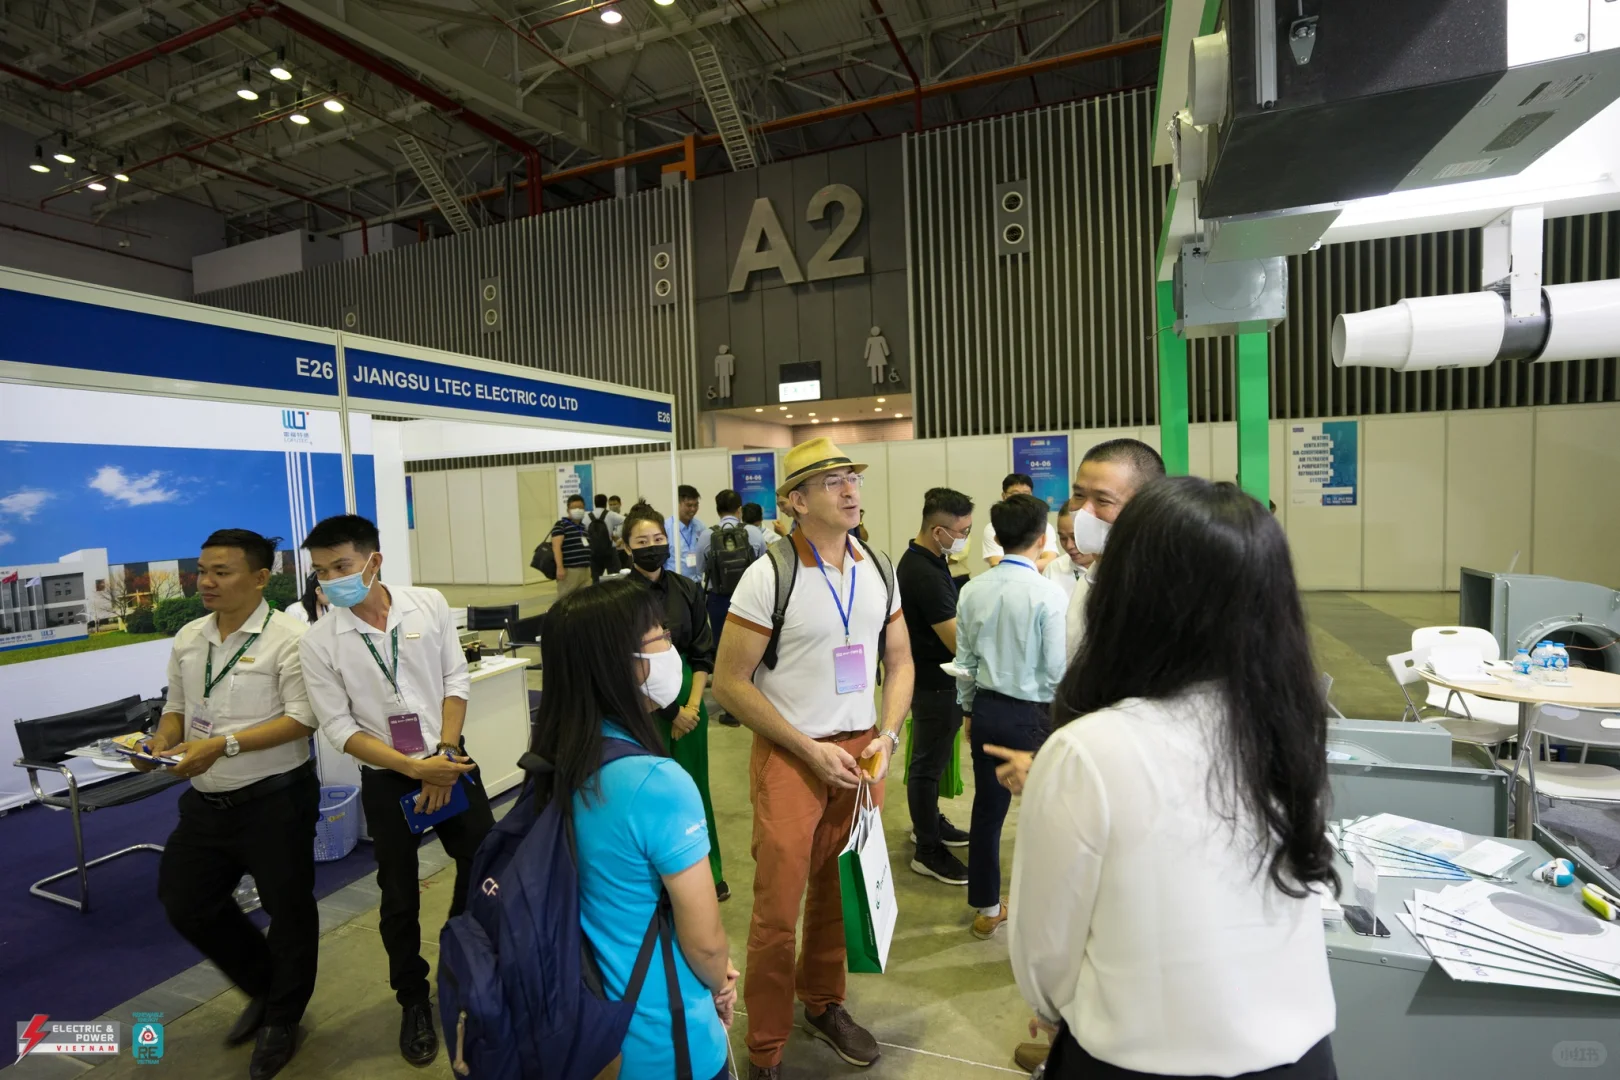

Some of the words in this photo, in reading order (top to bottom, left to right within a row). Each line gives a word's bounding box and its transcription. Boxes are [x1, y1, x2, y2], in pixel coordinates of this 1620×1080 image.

[728, 183, 865, 293] A2
[296, 357, 334, 380] E26
[353, 365, 430, 392] JIANGSU
[435, 378, 471, 397] LTEC
[475, 384, 537, 406] ELECTRIC
[540, 393, 556, 409] CO
[559, 398, 578, 411] LTD
[657, 411, 671, 423] E26
